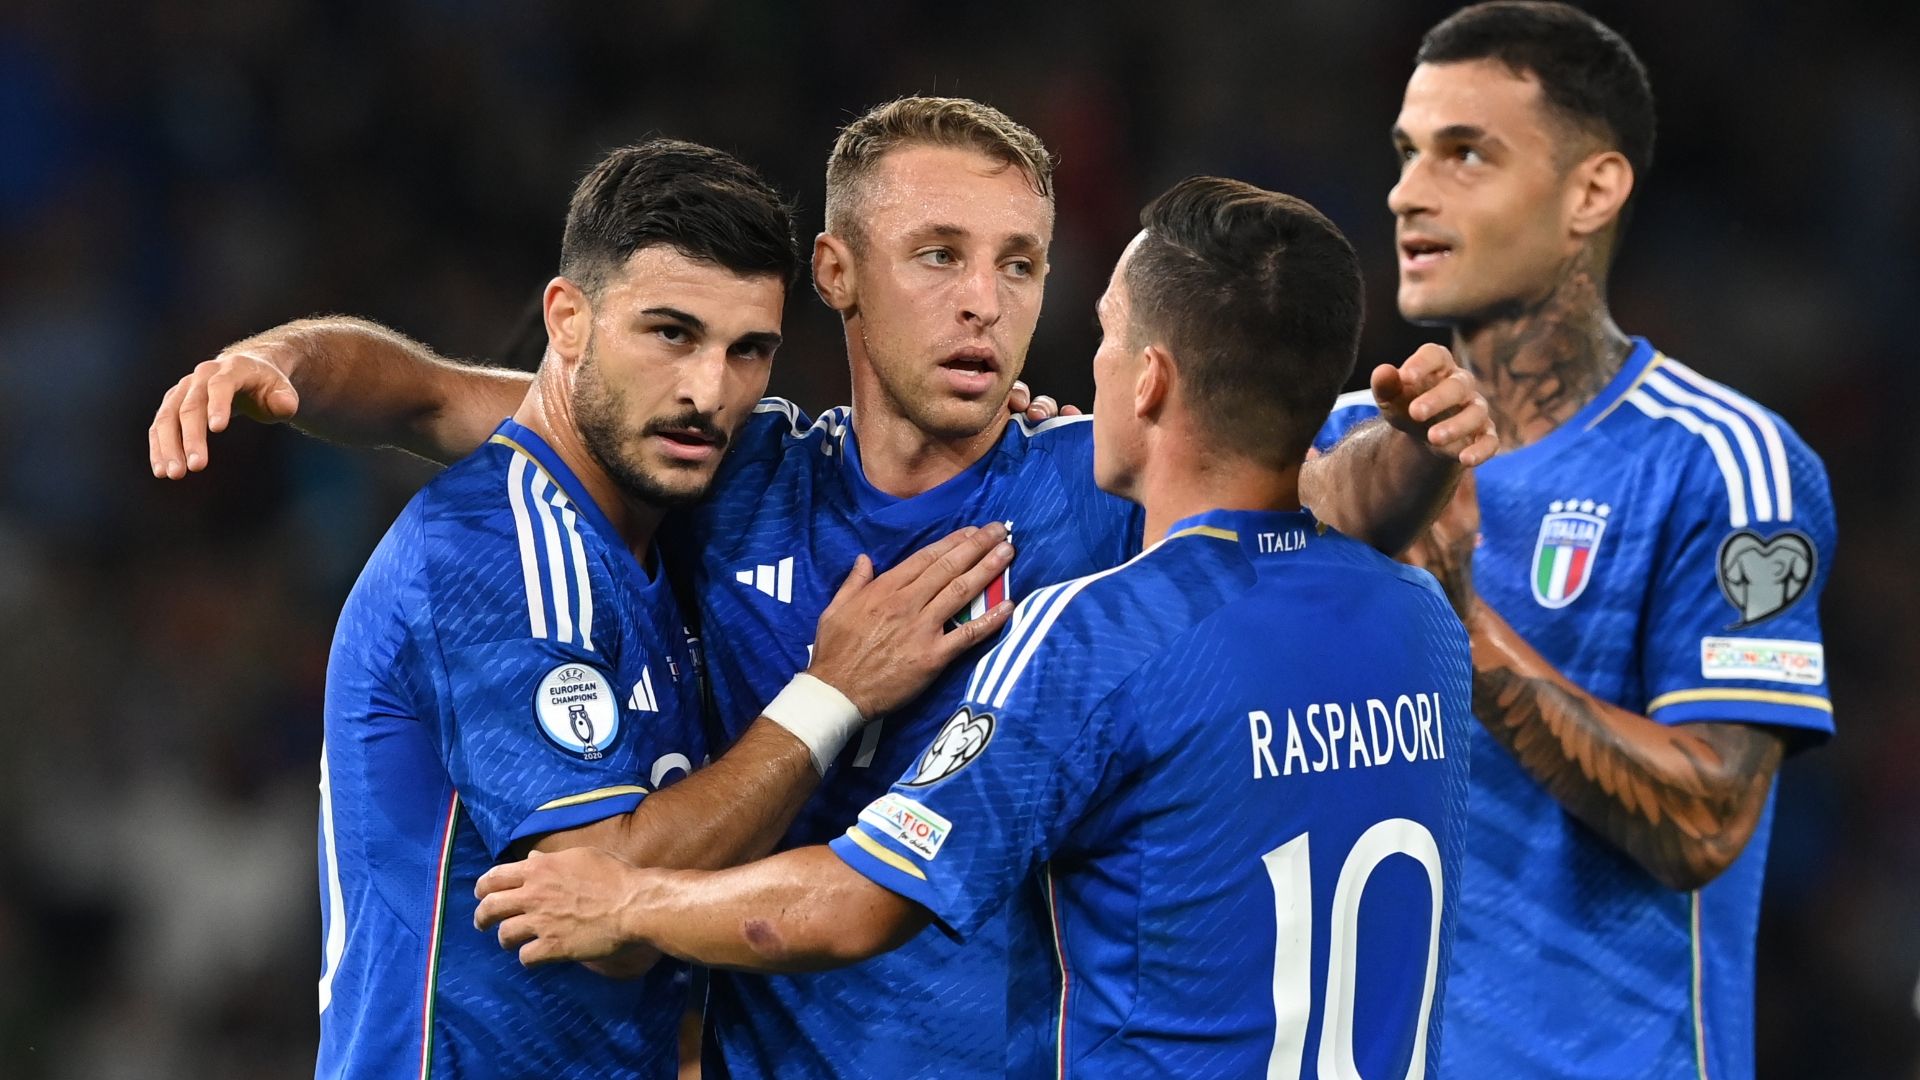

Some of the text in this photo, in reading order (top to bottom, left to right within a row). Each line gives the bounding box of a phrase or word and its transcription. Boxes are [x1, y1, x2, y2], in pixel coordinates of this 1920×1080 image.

[1545, 520, 1597, 540] ITALIA
[1257, 529, 1307, 553] ITALIA
[560, 670, 583, 680] UEFA
[550, 682, 596, 695] EUROPEAN
[552, 693, 597, 704] CHAMPIONS
[1248, 692, 1445, 779] RASPADORI
[584, 752, 602, 760] 2020
[1261, 817, 1444, 1080] 10
